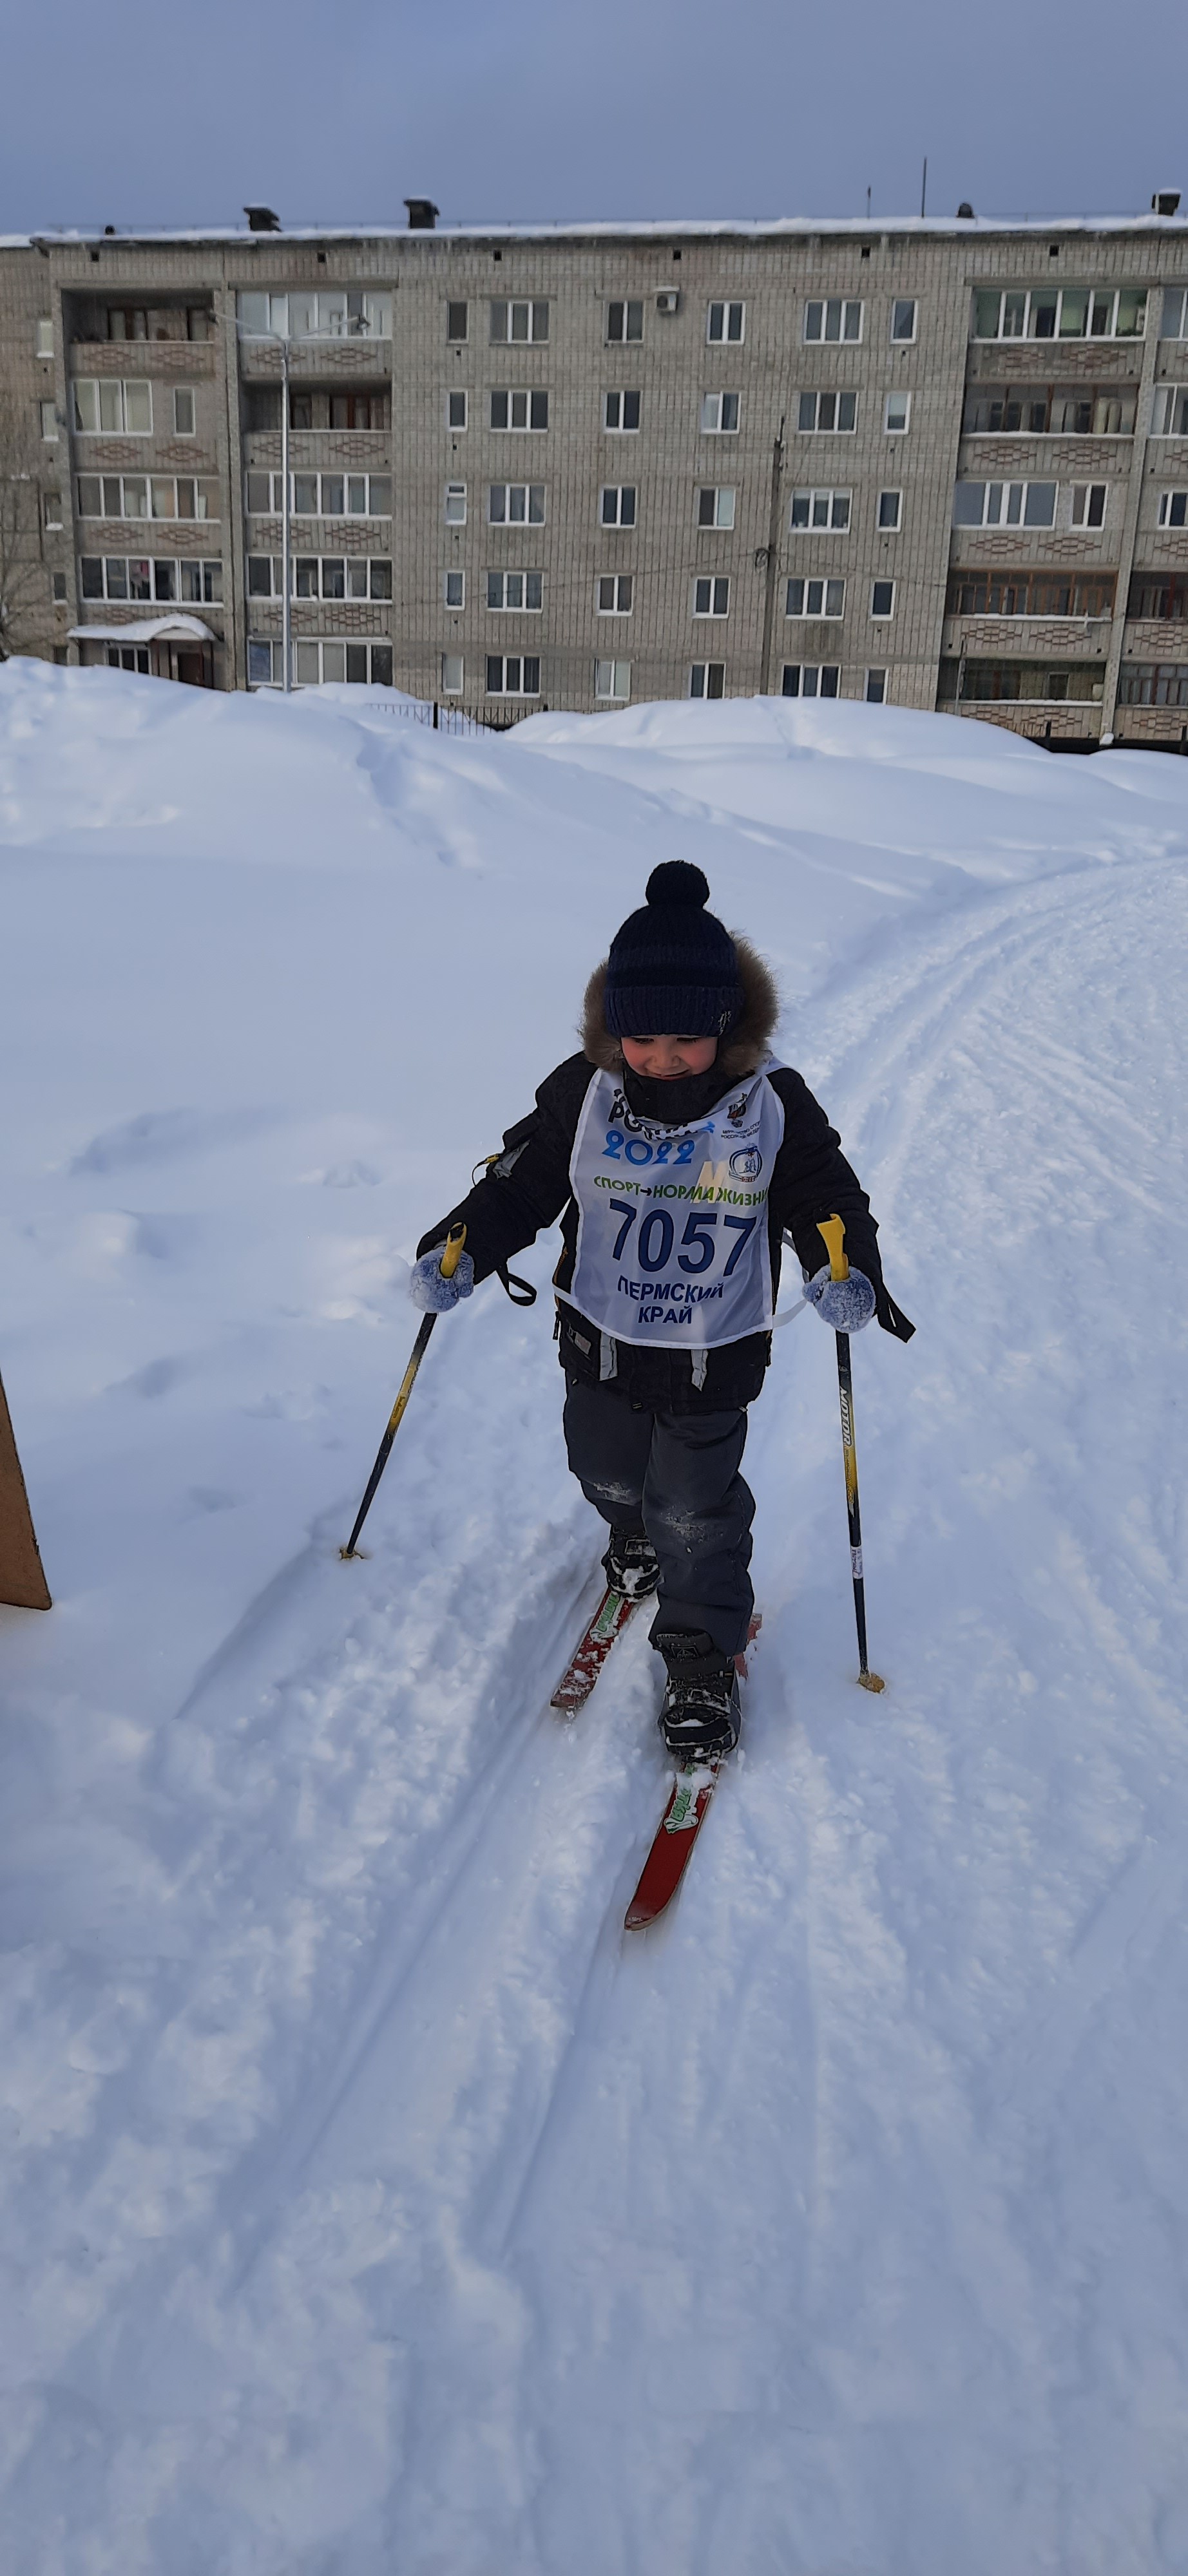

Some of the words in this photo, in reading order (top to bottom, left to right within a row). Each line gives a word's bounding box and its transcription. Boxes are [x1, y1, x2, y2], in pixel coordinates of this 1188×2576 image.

[602, 1129, 695, 1166] 2022
[593, 1175, 641, 1196] СПОРТ
[653, 1184, 715, 1201] НОРМА
[716, 1186, 769, 1206] ЖИЗНИ
[609, 1198, 757, 1277] 7057
[617, 1275, 725, 1303] ПЕРМСКИЙ
[638, 1305, 693, 1324] КРАЙ
[839, 1385, 852, 1446] MOTOR
